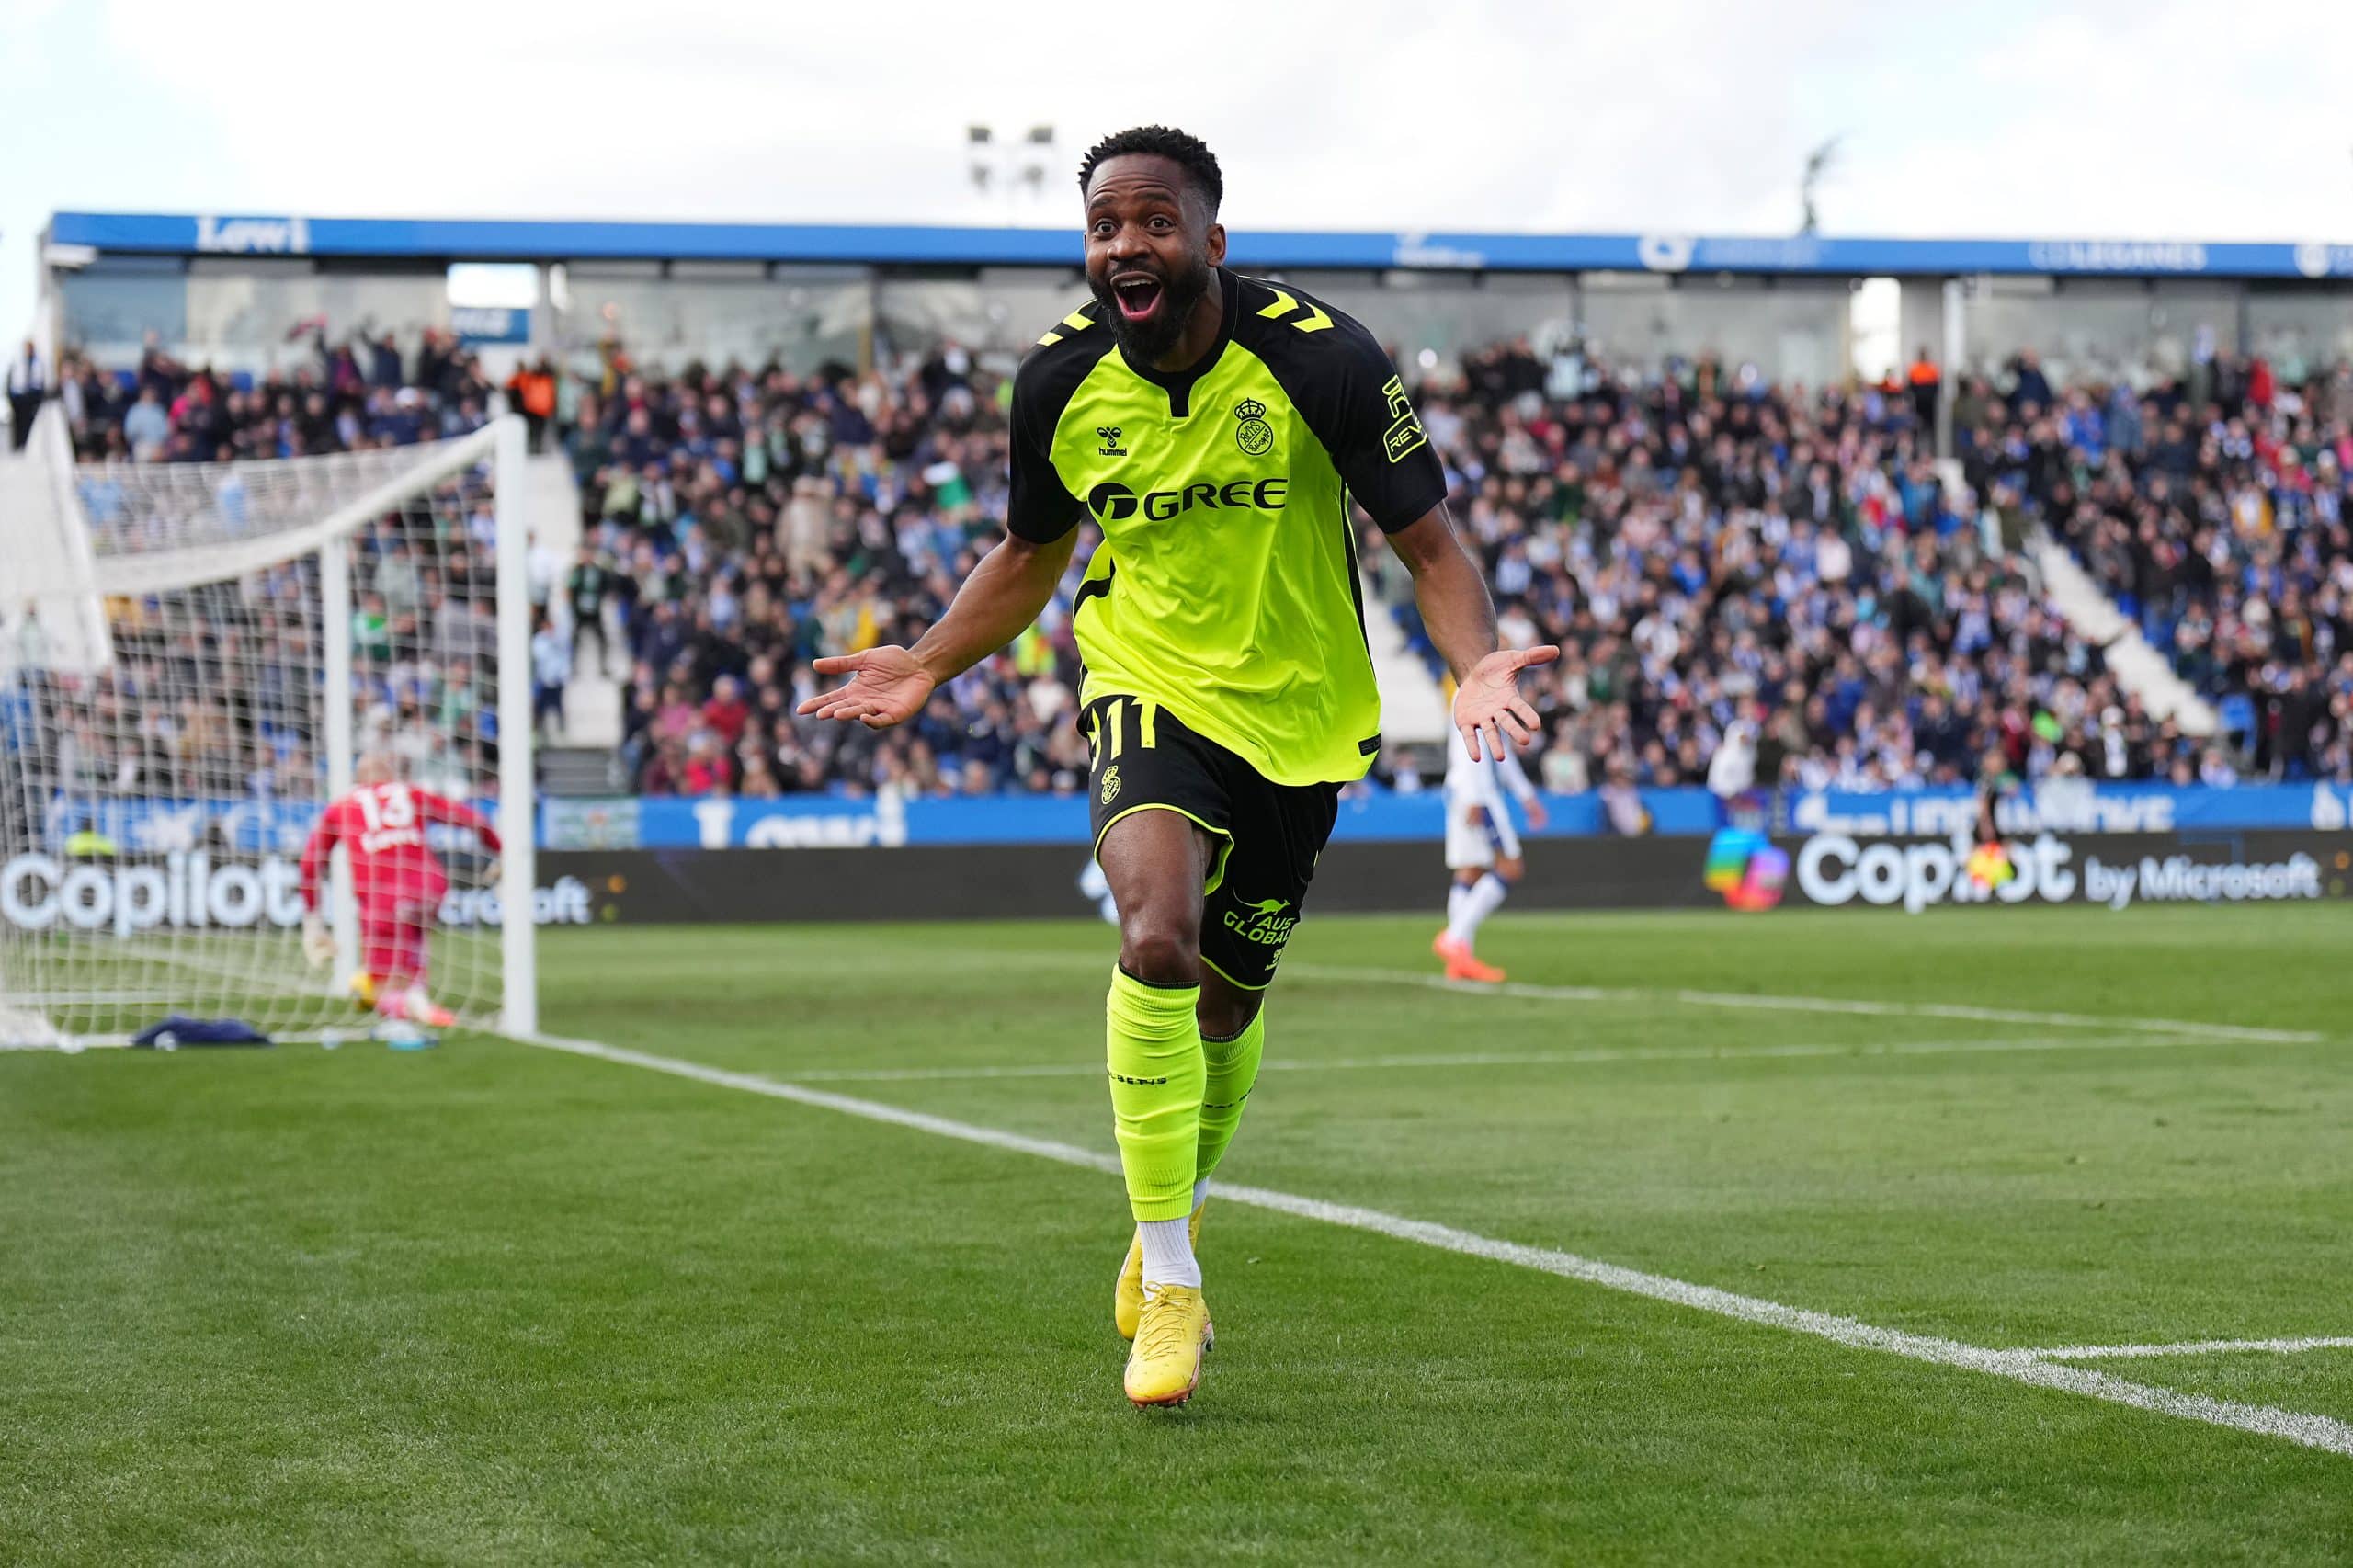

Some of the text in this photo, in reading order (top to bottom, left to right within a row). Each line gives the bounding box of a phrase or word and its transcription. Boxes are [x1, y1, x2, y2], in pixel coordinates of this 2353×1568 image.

[1098, 447, 1127, 457] hummel
[1144, 478, 1288, 521] GREE
[353, 782, 412, 832] 13
[2085, 855, 2137, 911] by
[2139, 851, 2322, 901] Microsoft
